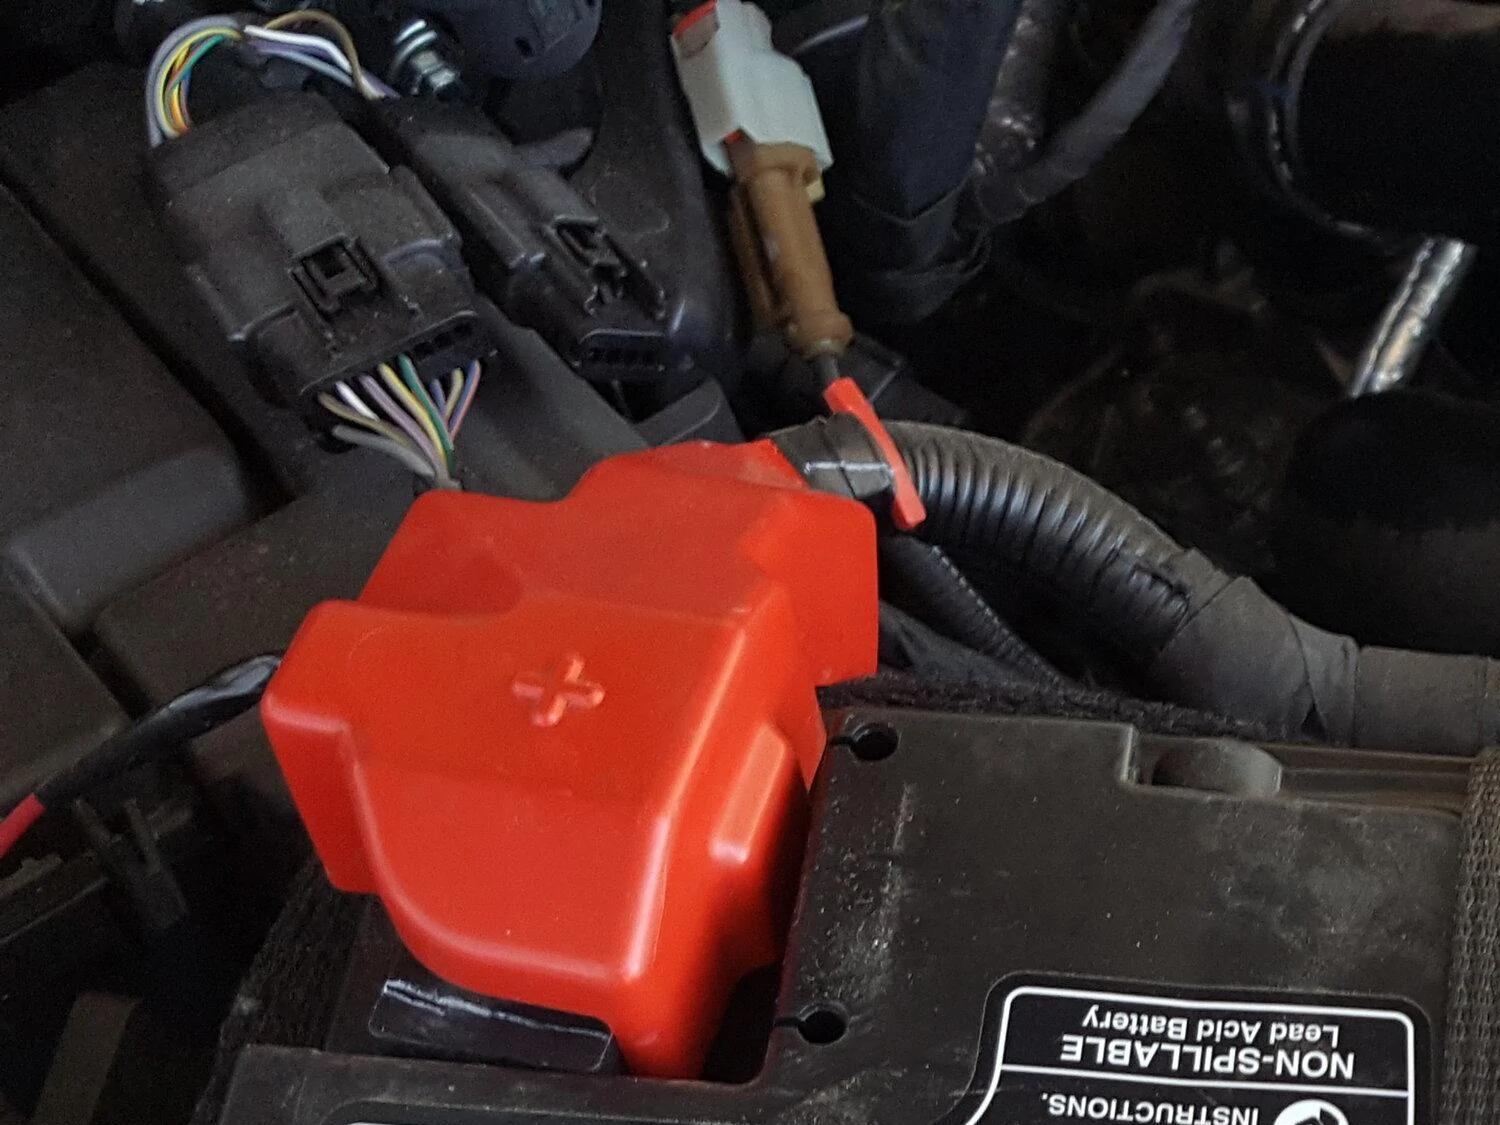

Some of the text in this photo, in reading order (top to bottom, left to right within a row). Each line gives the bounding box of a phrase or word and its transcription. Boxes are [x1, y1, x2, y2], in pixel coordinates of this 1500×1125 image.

[1082, 1004, 1340, 1049] Lead Acid Battery
[1060, 1034, 1355, 1080] NON-SPILLABLE
